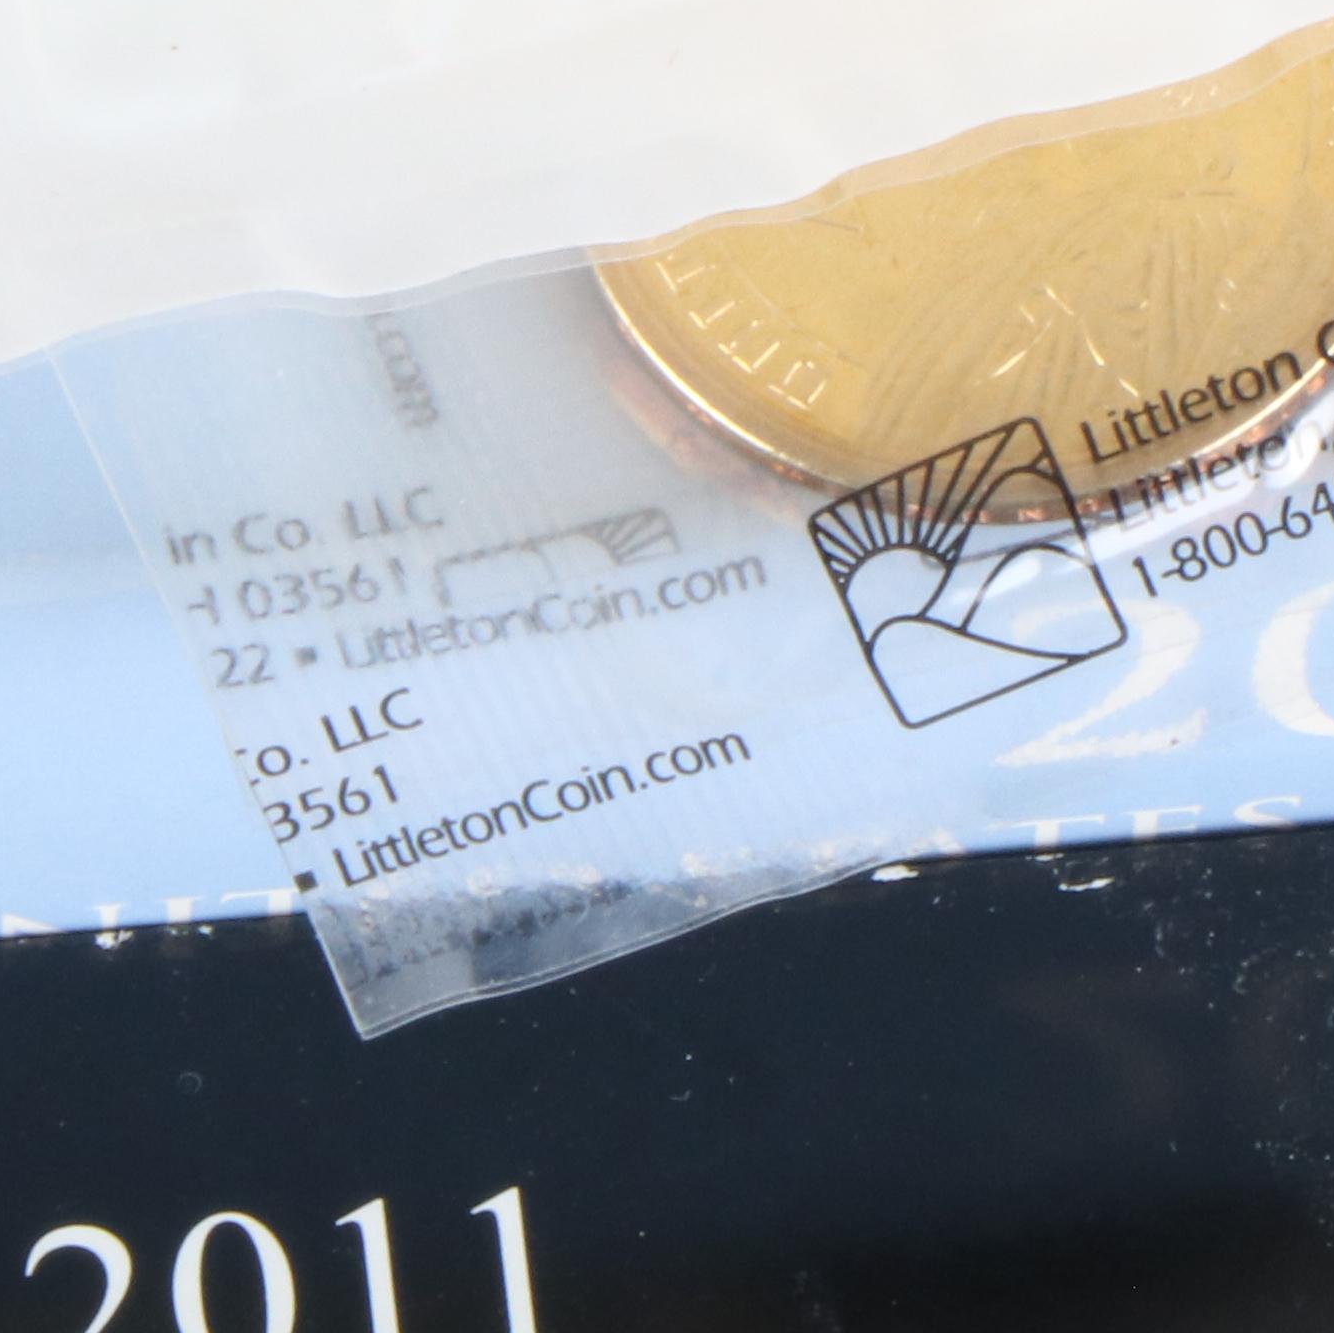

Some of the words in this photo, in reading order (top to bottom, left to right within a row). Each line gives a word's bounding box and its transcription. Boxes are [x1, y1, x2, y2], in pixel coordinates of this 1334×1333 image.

[1079, 348, 1303, 464] Littleton
[342, 485, 445, 540] LLC
[237, 556, 408, 620] 03561
[335, 552, 770, 671] LittletonCoin.com
[236, 744, 310, 787] o.
[321, 686, 425, 754] LLC
[332, 725, 753, 889] LittletonCoin.com
[24, 1186, 540, 1333] 2011
